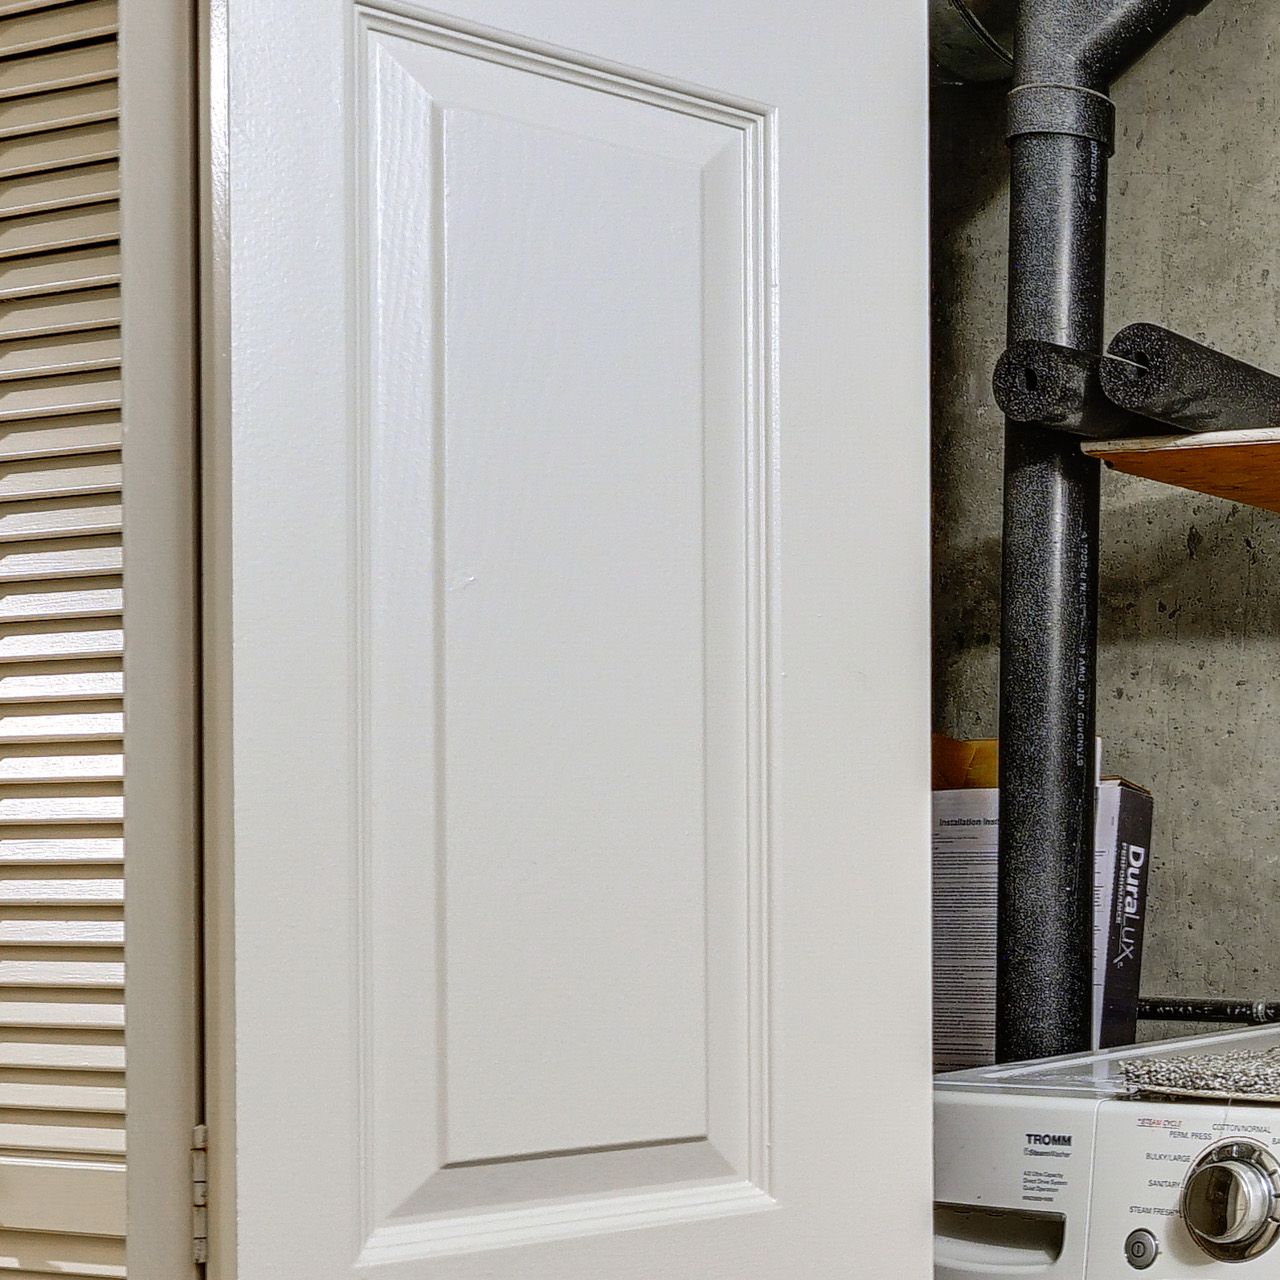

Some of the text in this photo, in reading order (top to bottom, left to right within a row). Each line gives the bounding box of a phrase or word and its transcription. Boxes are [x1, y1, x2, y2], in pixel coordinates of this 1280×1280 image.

[1115, 842, 1129, 924] PERFORMANCE
[1112, 843, 1146, 965] DuraLux
[1025, 1132, 1072, 1147] TROMM
[1190, 1131, 1213, 1141] PRESS
[1129, 1205, 1152, 1215] STEAM
